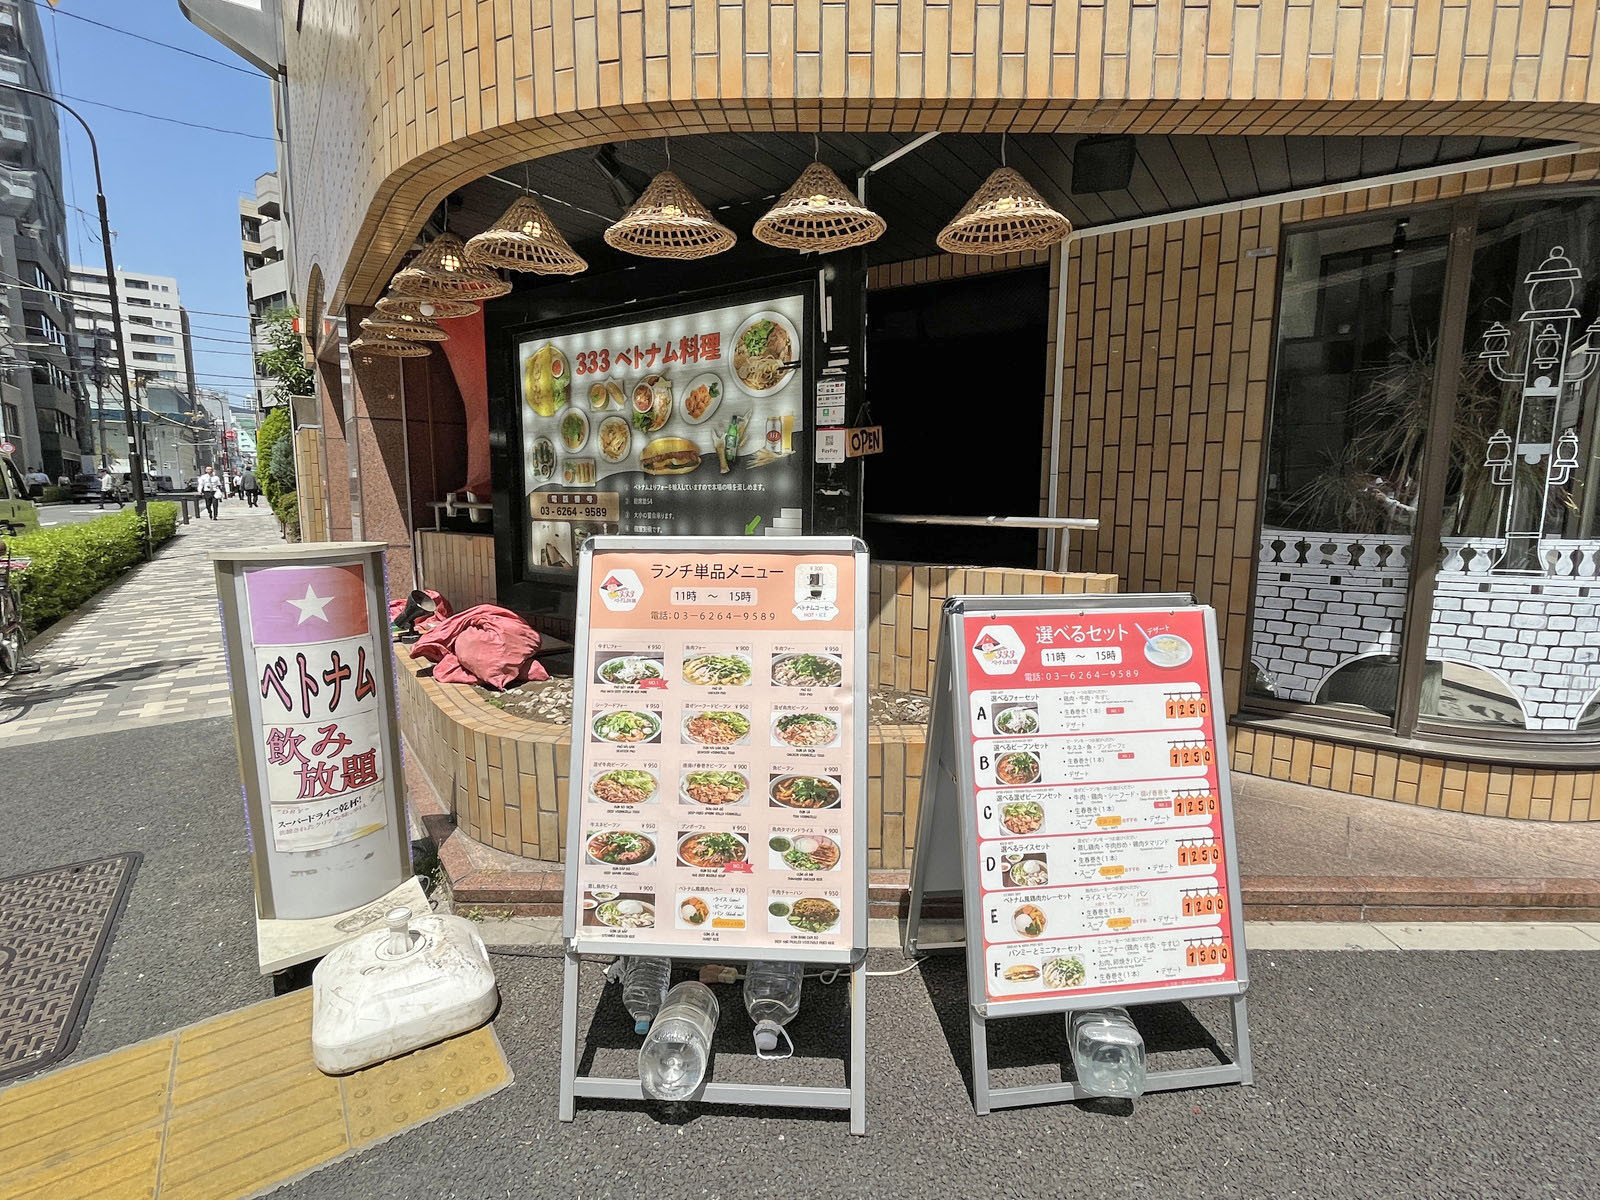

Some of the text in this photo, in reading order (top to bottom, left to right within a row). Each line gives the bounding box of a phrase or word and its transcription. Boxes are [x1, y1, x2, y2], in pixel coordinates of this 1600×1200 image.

[576, 332, 721, 375] 333 ベトナム料理
[851, 429, 880, 453] OPEN
[651, 564, 784, 580] ランチ単品メニュー
[676, 591, 697, 602] 11時
[729, 592, 752, 602] 15時
[1035, 624, 1128, 644] 選べるセット
[1147, 624, 1170, 635] デザート
[1046, 652, 1066, 662] 11時
[1096, 650, 1116, 661] 15時
[261, 646, 376, 718] ベトナム
[990, 694, 1040, 702] 選べるフォーセット
[977, 706, 986, 720] A
[1168, 703, 1206, 716] 1250
[266, 724, 352, 766] 飲み
[994, 744, 1048, 752] 選べるビーフンセット
[980, 756, 990, 770] B
[1173, 750, 1210, 764] 1250
[294, 748, 378, 800] 放題
[984, 806, 992, 820] C
[1178, 800, 1214, 812] 1250
[1000, 843, 1050, 853] 選べるライスセット
[1181, 848, 1219, 862] 1250
[986, 856, 996, 872] D
[1186, 898, 1224, 913] 1200
[991, 908, 998, 923] E
[1190, 948, 1228, 962] 1500
[994, 962, 1000, 977] F
